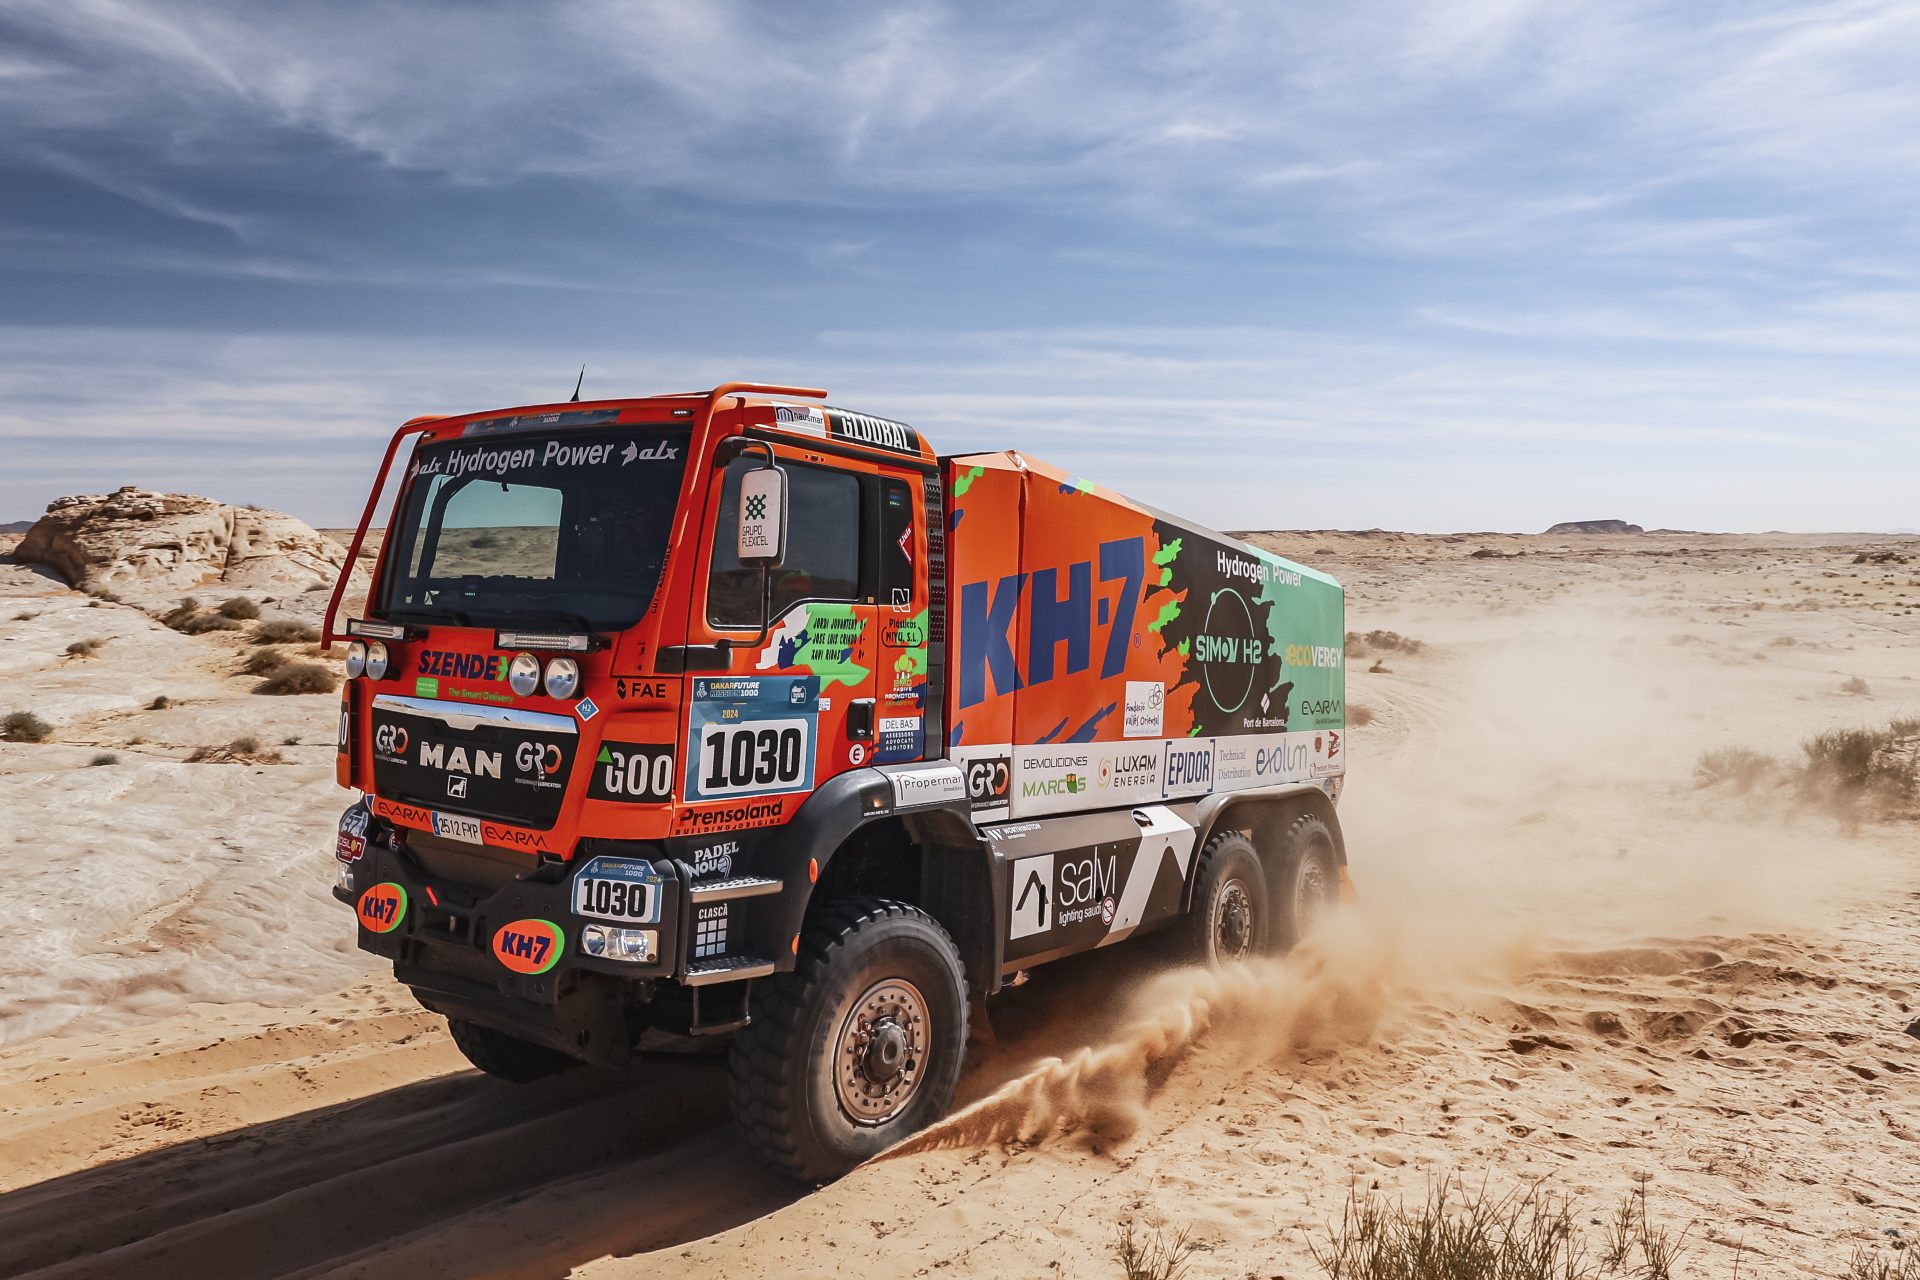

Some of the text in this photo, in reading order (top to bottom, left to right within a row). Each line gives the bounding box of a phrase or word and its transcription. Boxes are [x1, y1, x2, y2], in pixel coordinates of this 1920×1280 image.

[842, 412, 912, 450] GLOOBAL
[446, 446, 535, 478] Hydrogen
[542, 441, 615, 467] Power
[742, 525, 762, 536] GRUPO
[742, 536, 768, 547] FLEXICEL
[1217, 550, 1302, 588] Hydrogen Power
[448, 688, 514, 704] The Smart Delivery
[631, 683, 666, 698] FAE
[582, 703, 592, 712] H2
[722, 710, 738, 718] 2024
[886, 720, 914, 730] DEL BAS
[1244, 717, 1284, 728] Port de Barcelona
[376, 724, 408, 754] GRO
[419, 741, 502, 778] MAN
[516, 742, 562, 774] GRO
[706, 728, 802, 788] 1030
[1024, 756, 1088, 770] DEMOLICIONES
[1115, 755, 1156, 773] LUXAM
[1219, 748, 1246, 762] Technical
[904, 775, 962, 790] Propermar
[968, 762, 1009, 798] GRO
[1114, 773, 1156, 788] ENERGÍA
[1218, 767, 1252, 780] Distribution
[680, 799, 784, 826] Prensoland
[438, 818, 478, 840] 2512 FYP
[675, 818, 782, 836] BUILDING ORIGINS
[694, 842, 740, 863] PADEL
[685, 858, 718, 878] NOU
[1060, 844, 1116, 906] salvi
[583, 879, 647, 918] 1030
[698, 903, 728, 920] CLASCÀ
[1058, 903, 1102, 927] lighting saudi
